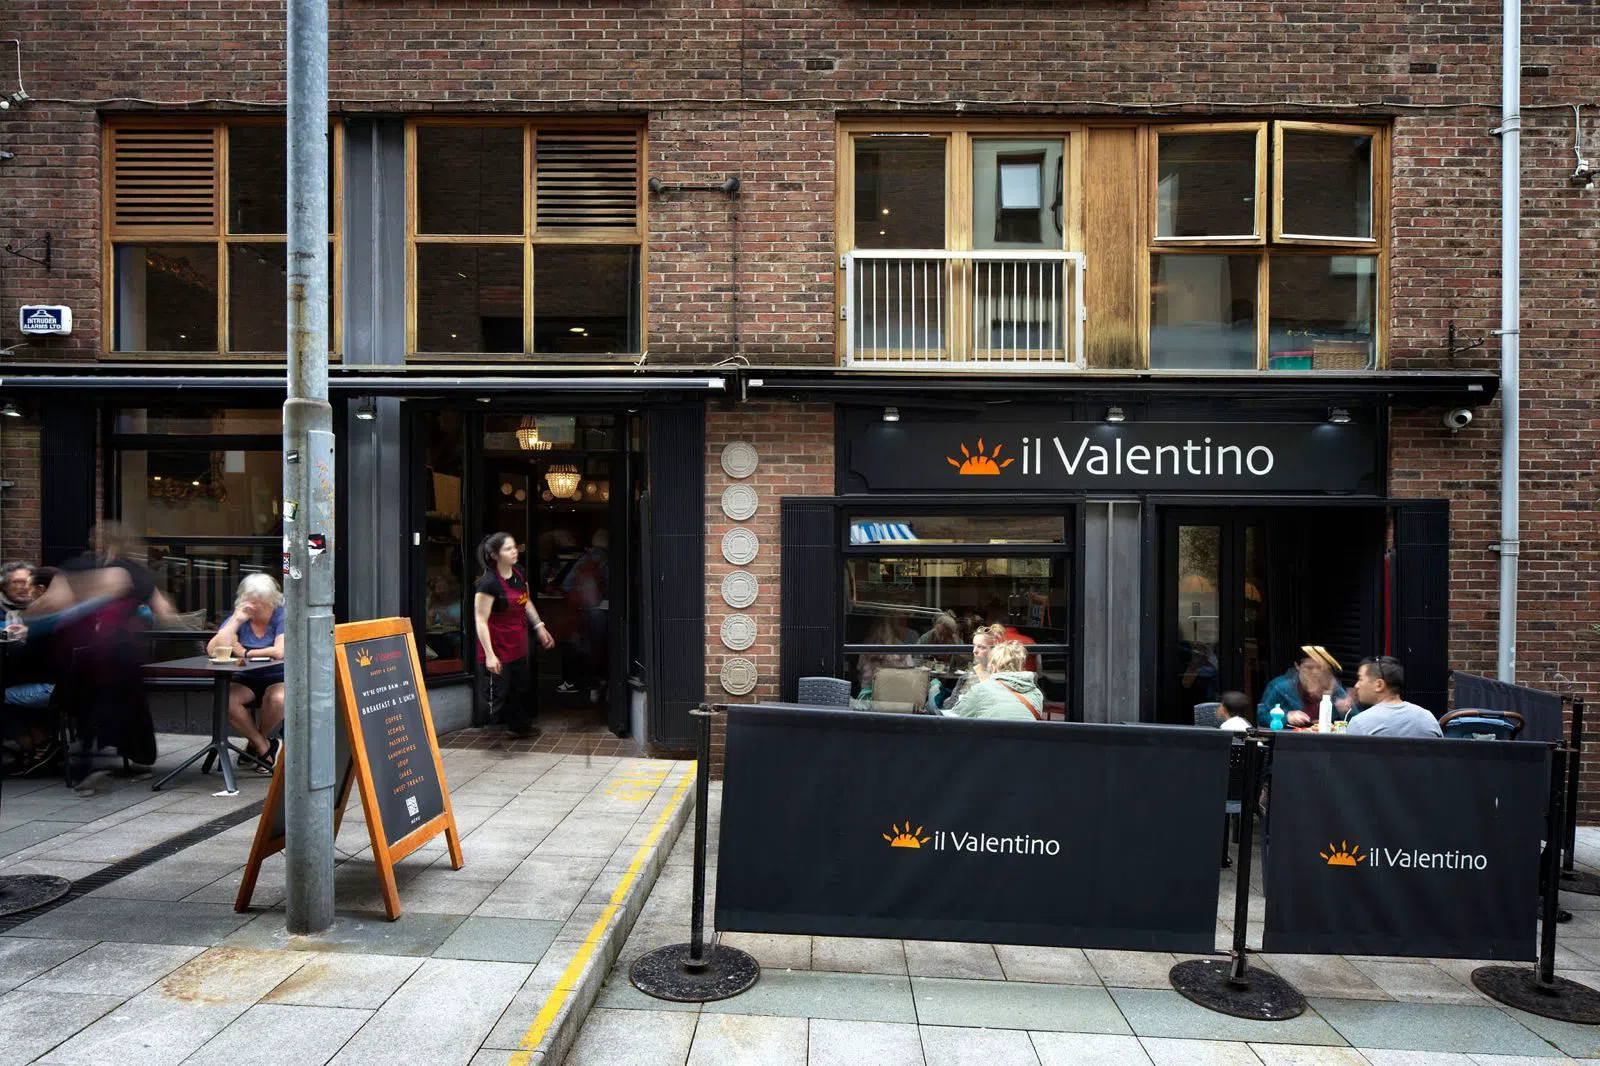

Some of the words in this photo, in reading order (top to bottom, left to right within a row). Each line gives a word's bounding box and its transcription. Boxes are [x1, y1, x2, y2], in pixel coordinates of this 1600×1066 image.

[1022, 437, 1041, 475] il
[1053, 437, 1274, 476] Valentino
[376, 686, 387, 694] OPEN
[362, 700, 391, 715] BREAKFAST
[385, 714, 402, 724] COFFEE
[388, 725, 405, 735] SCONES
[389, 735, 409, 747] PASTRIES
[388, 743, 417, 760] SANDWICHES
[397, 759, 409, 768] SOUP
[408, 776, 425, 788] TREATS
[934, 829, 946, 852] il
[951, 830, 1061, 857] Valentino
[1370, 846, 1379, 867] il
[1384, 847, 1488, 870] Valentino
